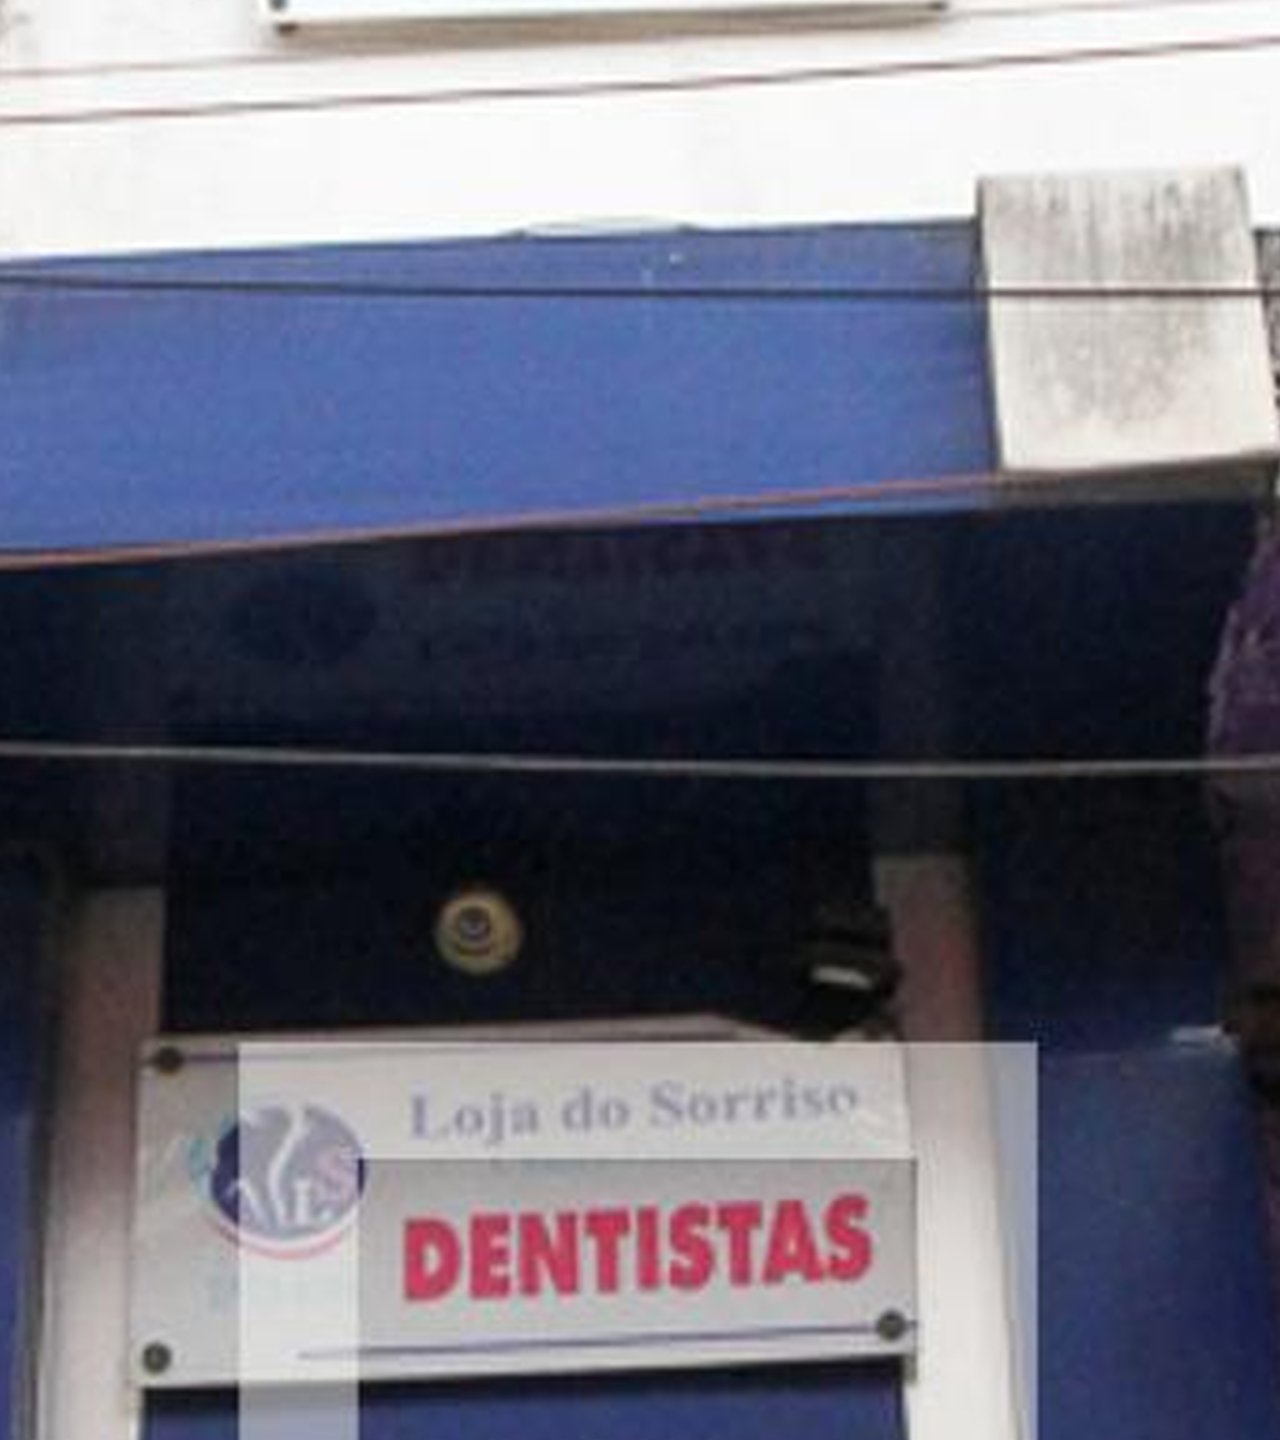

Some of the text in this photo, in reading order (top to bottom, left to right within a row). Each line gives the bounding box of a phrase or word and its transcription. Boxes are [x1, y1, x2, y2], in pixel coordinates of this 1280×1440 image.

[411, 1078, 858, 1144] Loja do Sorriso
[404, 1192, 873, 1302] DENTISTAS
